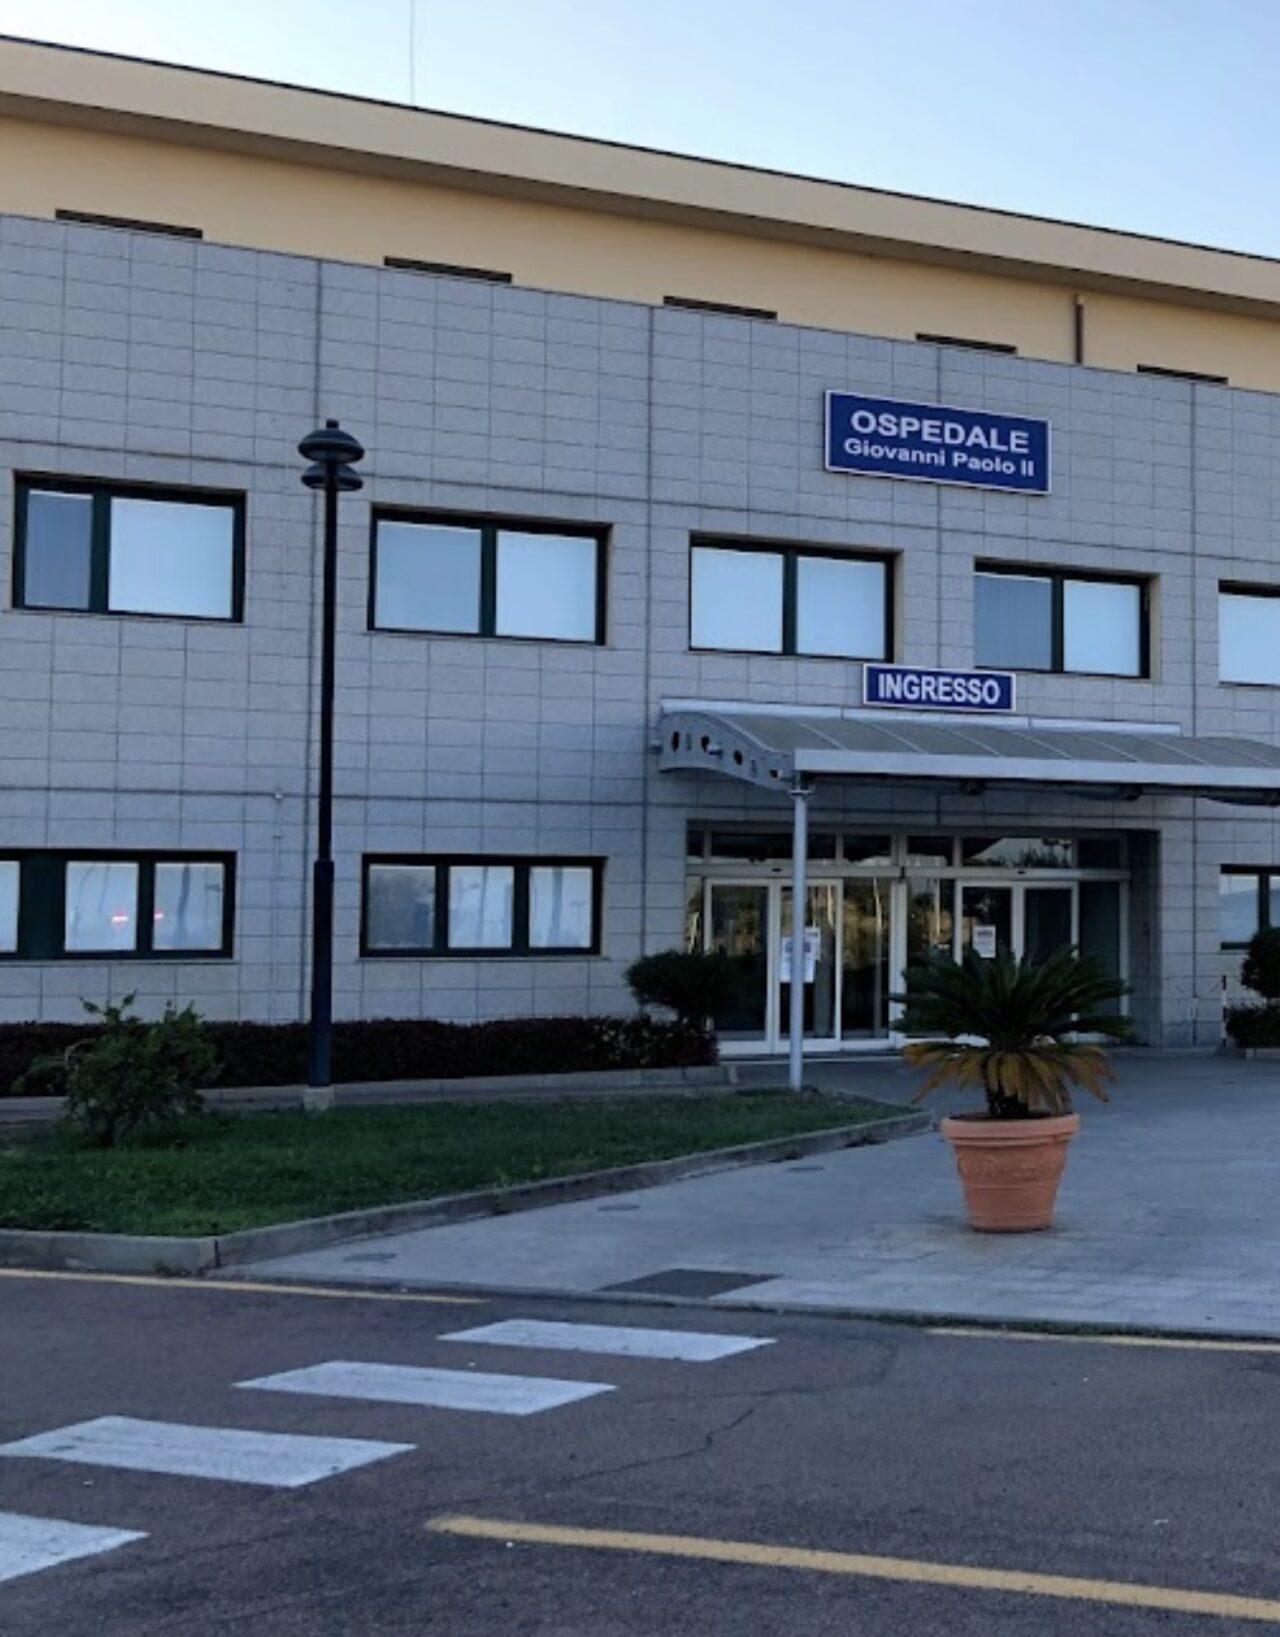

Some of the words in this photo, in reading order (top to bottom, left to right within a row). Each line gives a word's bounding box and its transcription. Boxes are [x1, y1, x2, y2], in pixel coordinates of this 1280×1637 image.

[851, 410, 1029, 454] OSPEDALE
[844, 438, 945, 466] Giovanni
[953, 452, 1015, 474] Paolo
[1020, 460, 1034, 477] II
[878, 673, 1000, 704] INGRESSO
